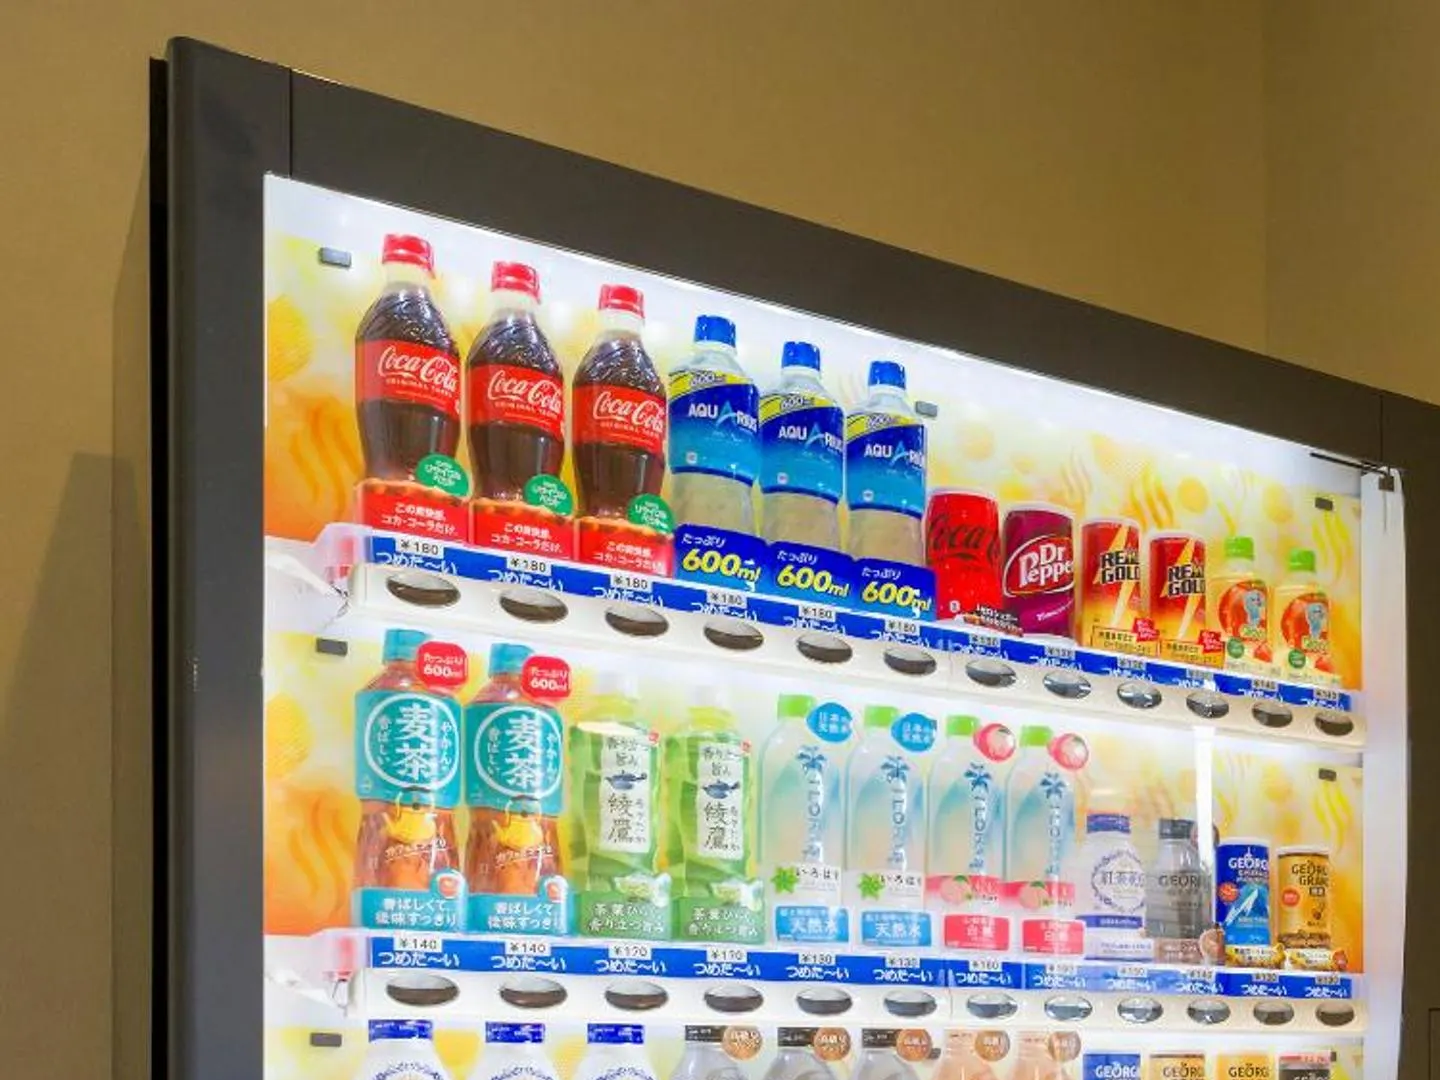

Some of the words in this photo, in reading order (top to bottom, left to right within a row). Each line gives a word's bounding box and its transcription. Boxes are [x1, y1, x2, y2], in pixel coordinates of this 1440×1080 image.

[378, 345, 459, 393] Coca-Cola
[488, 370, 562, 414] Coca-Cola
[593, 391, 665, 433] Coca-Cola
[778, 422, 844, 452] AQUARIU
[864, 441, 925, 467] AQUARI
[400, 541, 439, 557] ¥180
[1040, 543, 1066, 566] Dr
[376, 552, 459, 576] つめた〜い
[510, 557, 547, 573] ¥180
[682, 549, 761, 582] 600ml
[1019, 552, 1074, 588] Peppe
[489, 568, 564, 592] つめた〜い
[613, 576, 649, 590] ¥180
[777, 565, 850, 598] 600ml
[1168, 579, 1206, 596] GOL
[861, 582, 932, 612] 600ml
[424, 664, 463, 678] 600ml
[530, 677, 567, 691] 600ml
[393, 702, 438, 780] 麦茶
[504, 713, 542, 788] 麦茶
[1228, 856, 1268, 870] GEORG
[1291, 862, 1328, 875] GEORG
[1158, 874, 1200, 887] GEOR
[1299, 876, 1329, 887] GRAN
[384, 898, 446, 911] 香ばしくて
[875, 921, 922, 938] 天然水
[399, 939, 437, 950] ¥140
[510, 942, 546, 953] ¥140
[378, 952, 460, 967] つめた〜い
[491, 955, 566, 971] つめた〜い
[594, 959, 667, 974] つめた〜い
[693, 963, 761, 977] つめた〜い
[785, 966, 849, 980] つめた〜い
[873, 969, 932, 982] つめた〜い
[955, 971, 1012, 985] つめた〜い
[1095, 1064, 1139, 1077] GEORG
[1163, 1063, 1205, 1078] GEORG
[1228, 1063, 1269, 1078] GEORG
